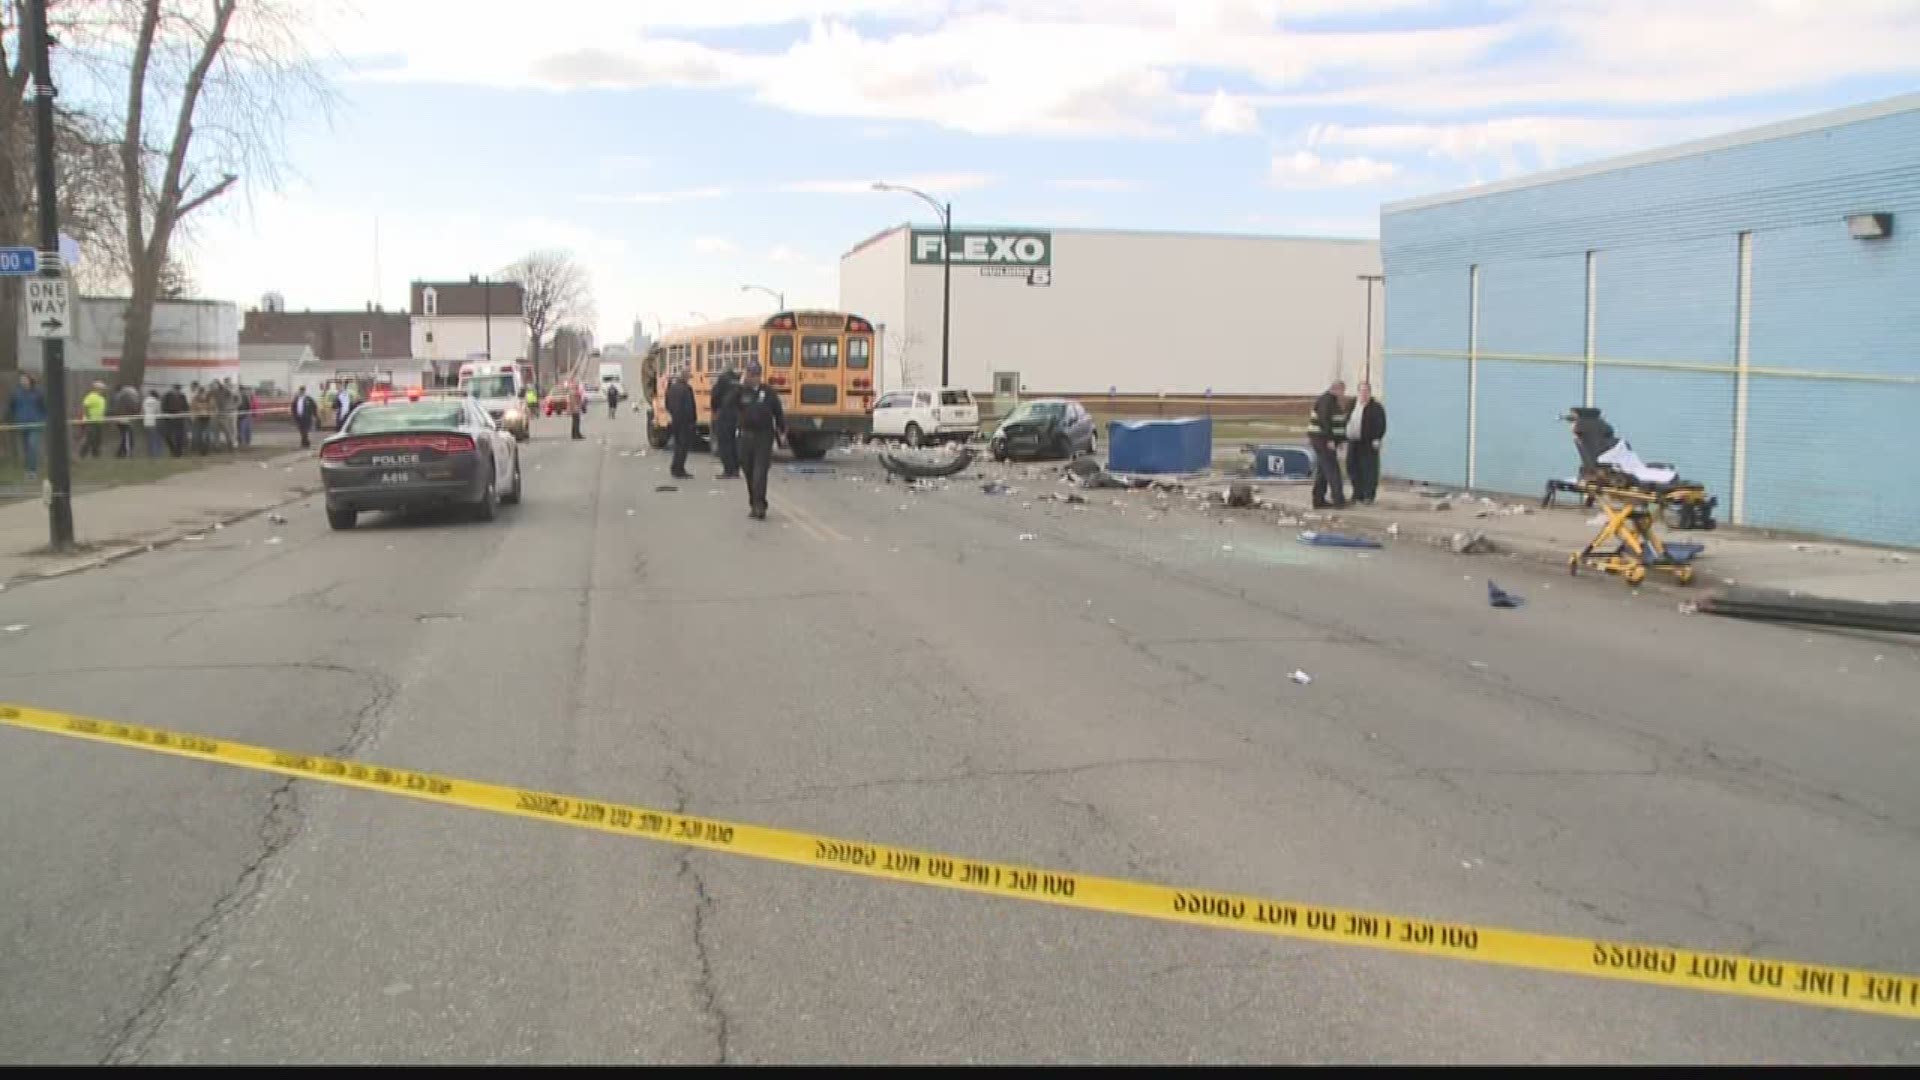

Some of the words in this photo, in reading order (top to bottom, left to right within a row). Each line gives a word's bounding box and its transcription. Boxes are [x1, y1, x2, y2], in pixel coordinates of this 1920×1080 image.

[916, 234, 1045, 263] FLEXO
[29, 282, 65, 298] ONE
[31, 299, 67, 313] WAY
[371, 454, 420, 466] POLICE
[1592, 942, 1677, 973] CROSS
[1686, 953, 1738, 982] NOT
